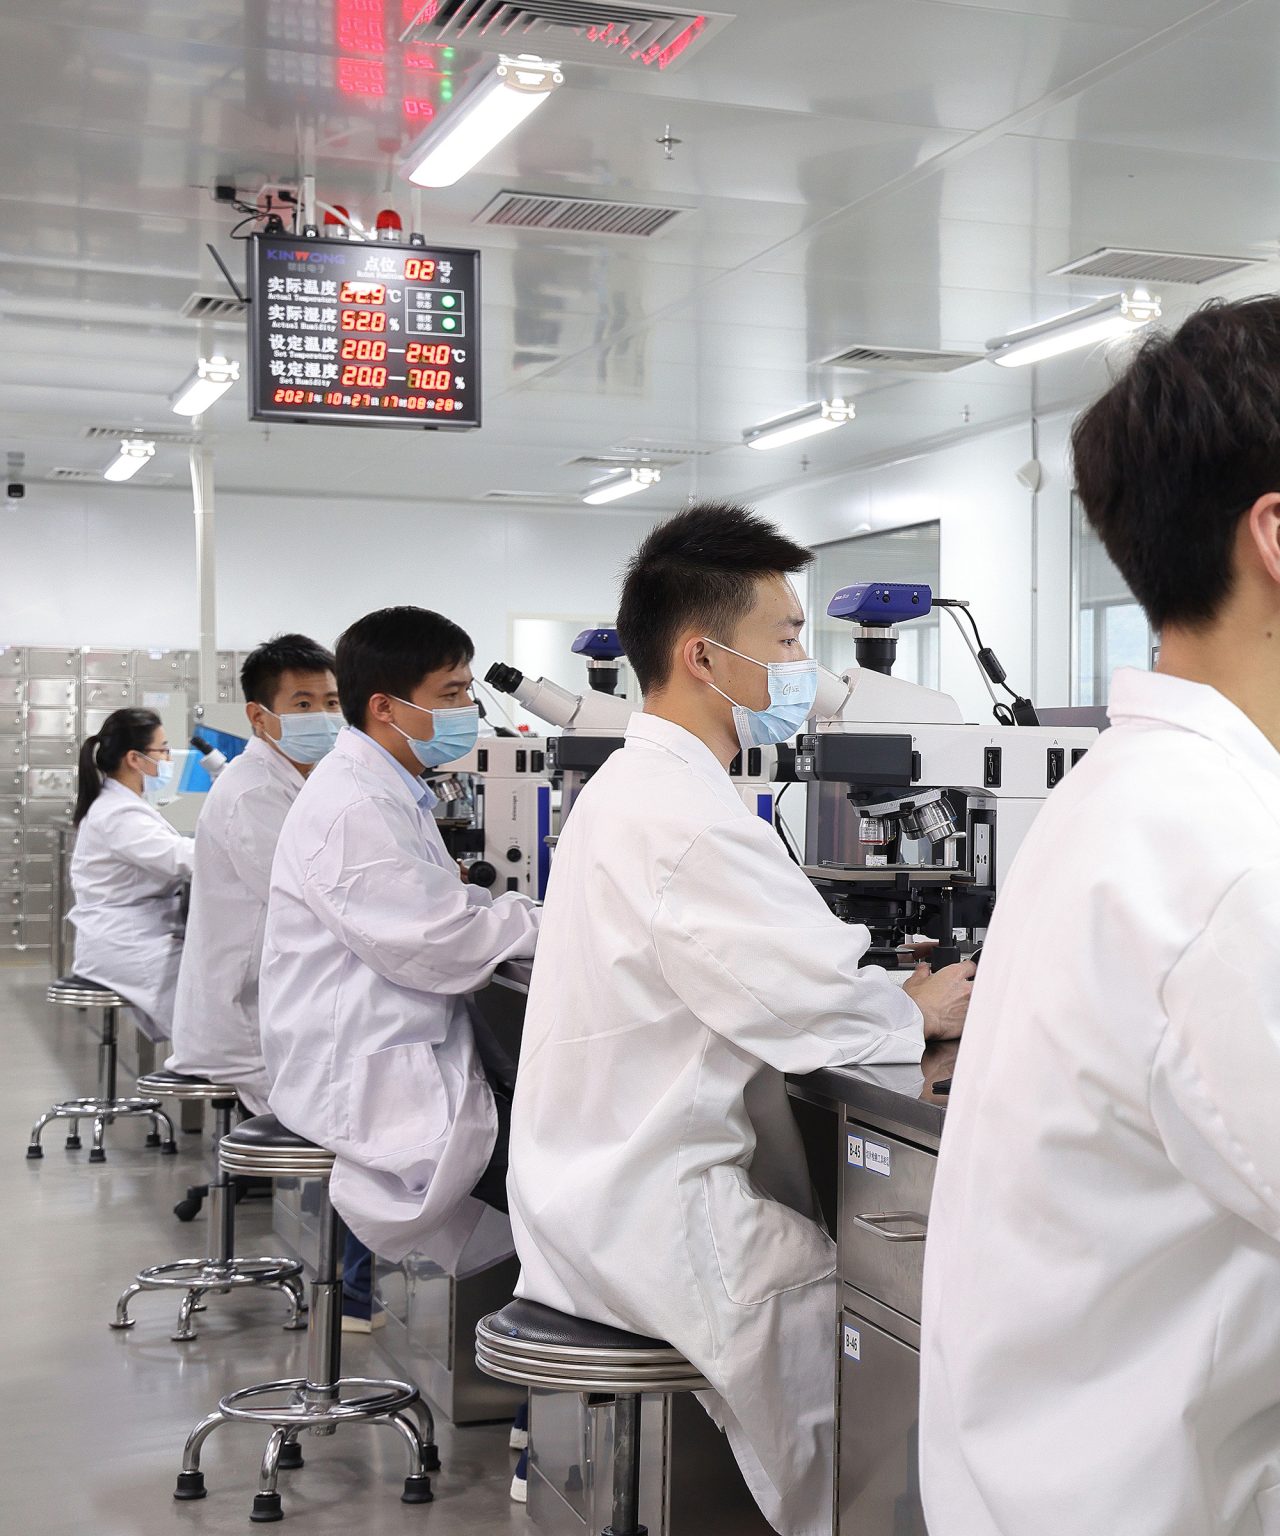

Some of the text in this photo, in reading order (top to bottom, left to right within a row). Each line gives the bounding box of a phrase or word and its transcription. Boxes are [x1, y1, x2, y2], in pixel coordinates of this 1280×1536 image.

[267, 250, 345, 264] KINWONG
[404, 259, 435, 281] 02
[438, 260, 453, 277] 号
[267, 276, 338, 297] 实际温度
[267, 304, 338, 324] 实际湿度
[388, 317, 400, 332] %
[268, 333, 339, 354] 设定温度
[268, 360, 339, 380] 设定湿度
[454, 376, 466, 390] %
